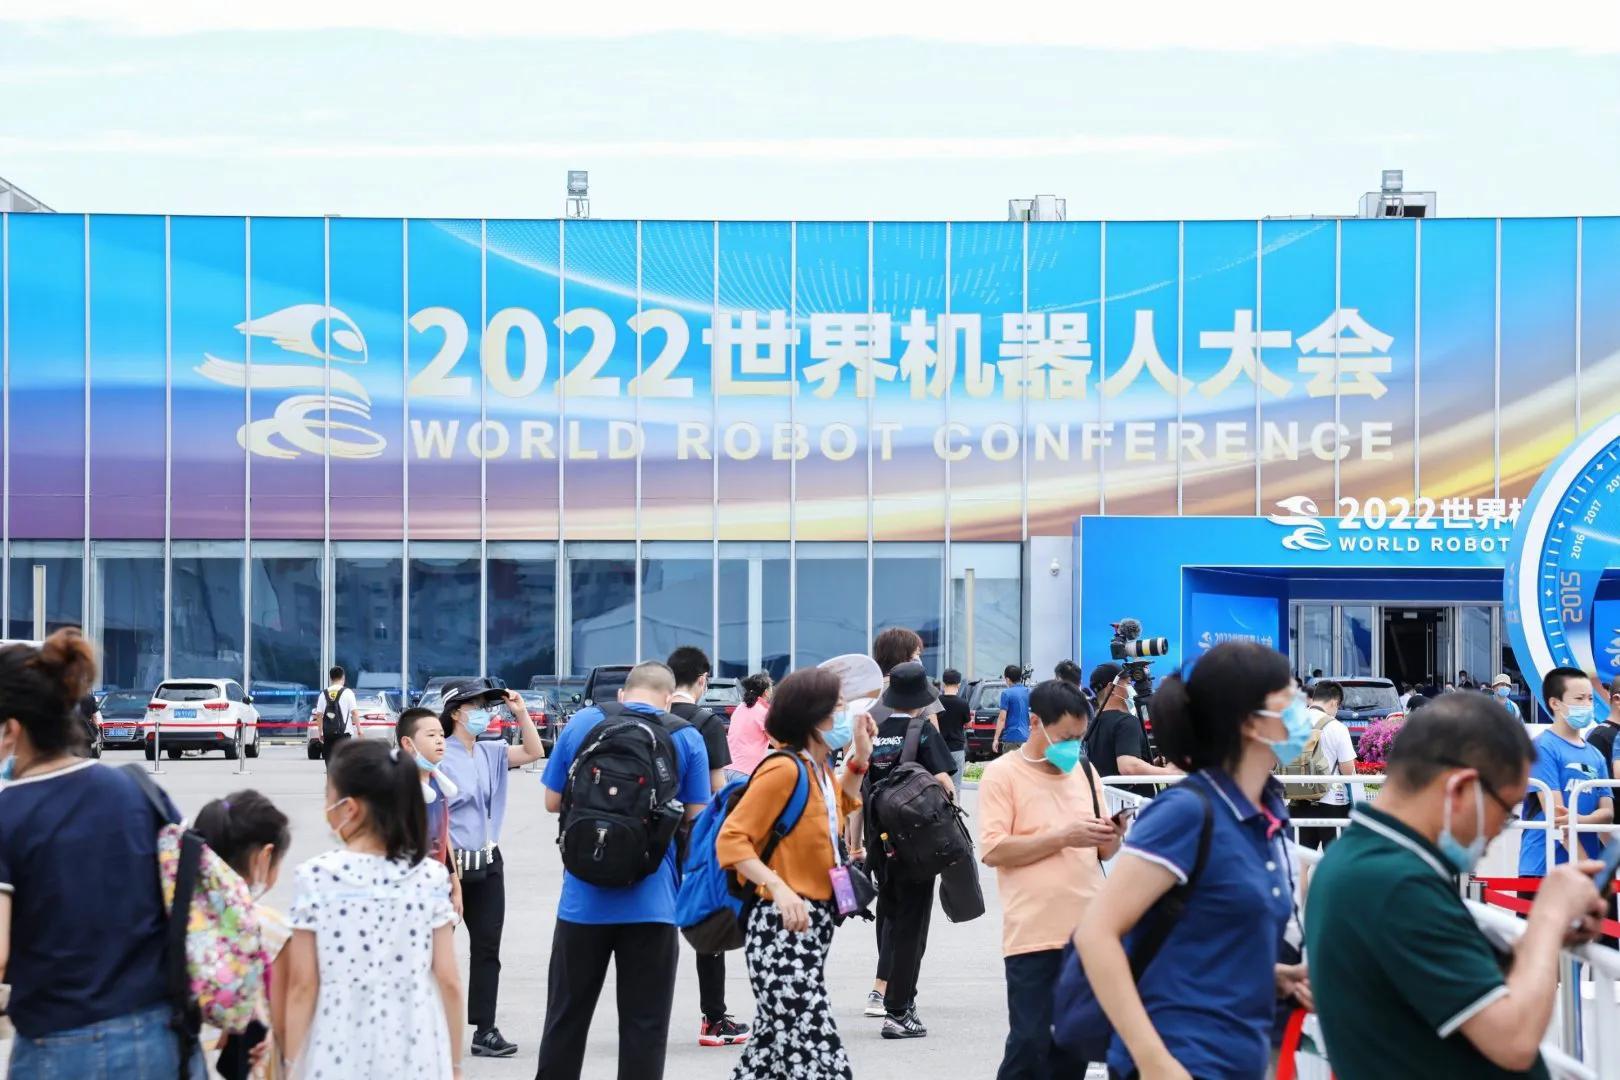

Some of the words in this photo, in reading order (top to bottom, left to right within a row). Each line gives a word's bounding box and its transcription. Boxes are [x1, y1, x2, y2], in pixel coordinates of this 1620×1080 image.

[408, 306, 1396, 400] 2022世界机器人大会
[411, 420, 646, 460] WORLD
[678, 420, 903, 462] ROBOT
[934, 420, 1394, 462] CONFERENCE
[1584, 500, 1602, 524] 2017
[1340, 536, 1420, 552] WORLD
[1432, 536, 1510, 552] ROBOT
[1571, 534, 1585, 558] 2016
[1561, 572, 1582, 621] 2015
